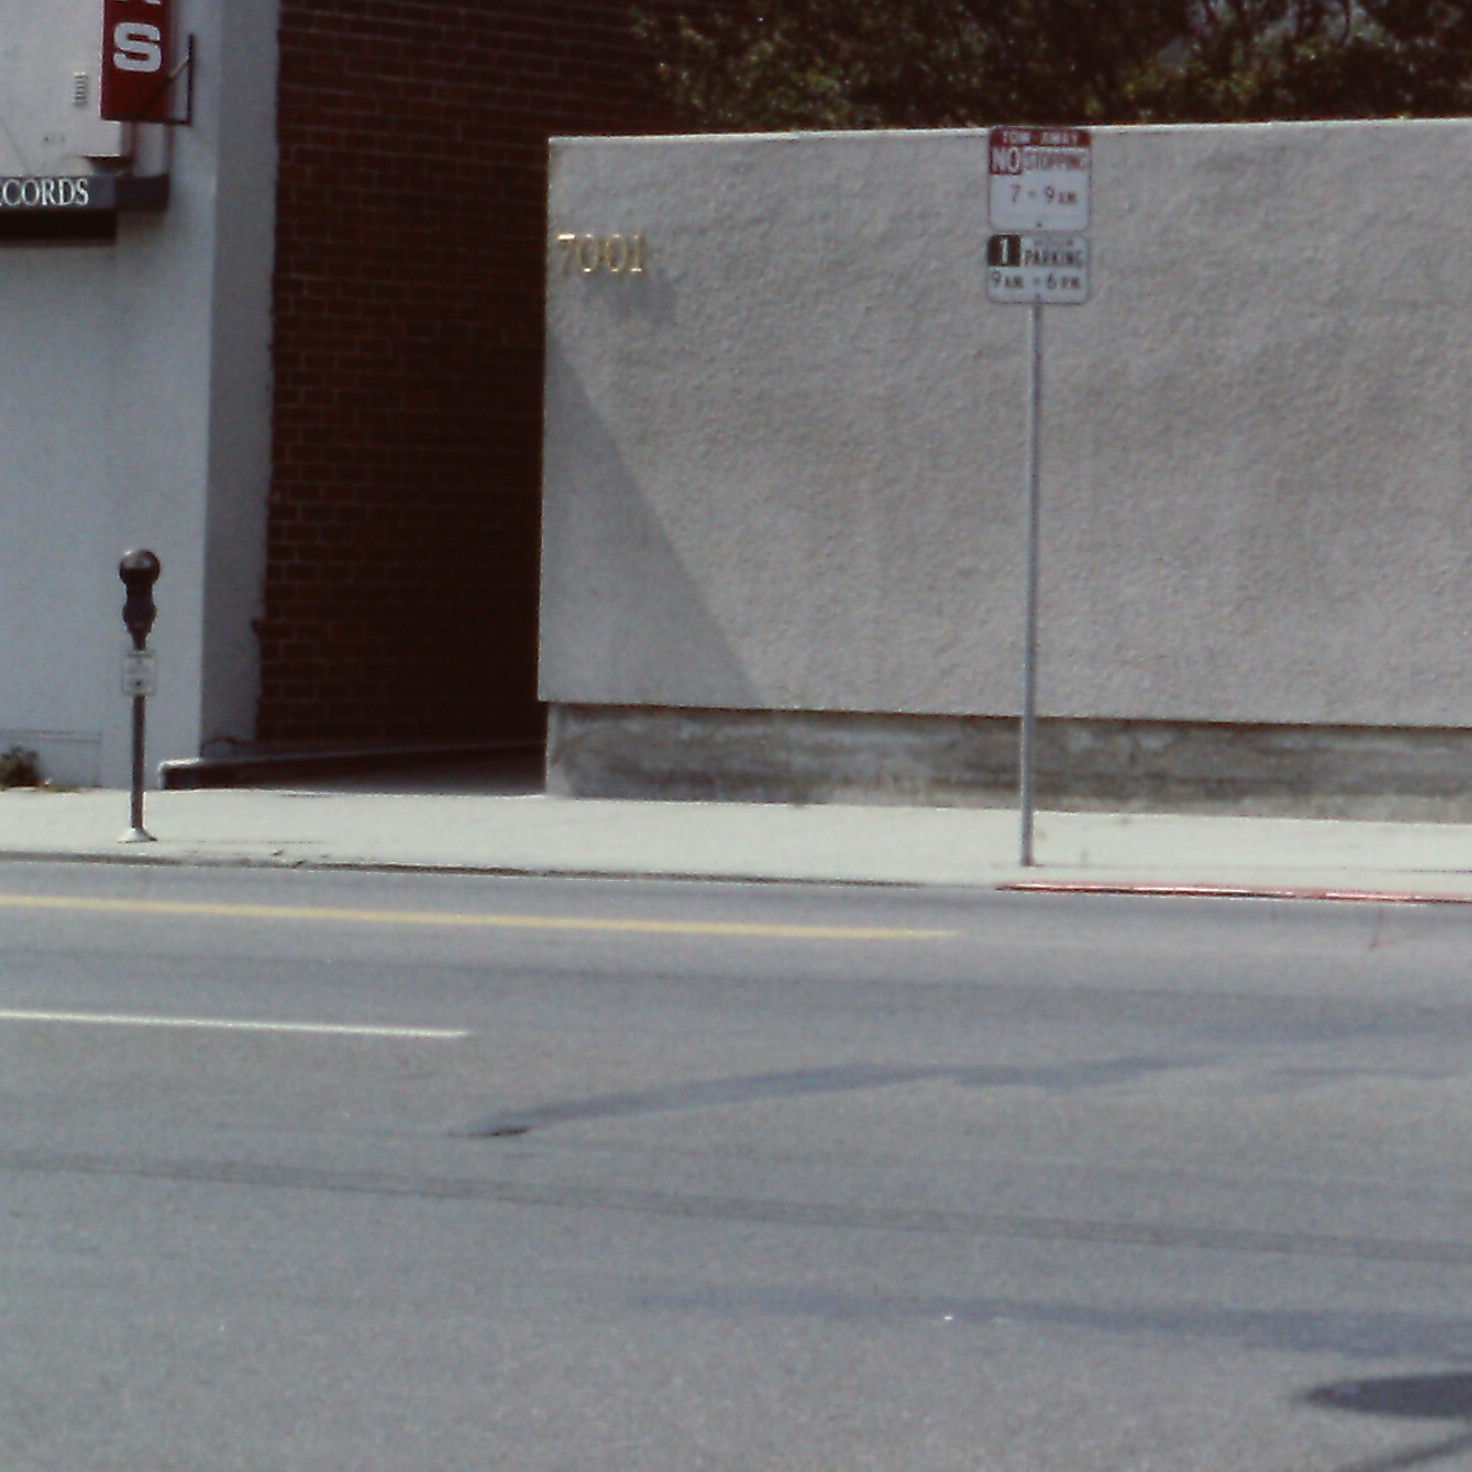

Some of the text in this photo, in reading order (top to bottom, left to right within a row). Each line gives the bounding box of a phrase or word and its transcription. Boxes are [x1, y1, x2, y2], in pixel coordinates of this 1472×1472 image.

[993, 147, 1020, 171] NO
[0, 178, 89, 206] CORDS
[558, 233, 642, 273] 7001
[1000, 237, 1009, 264] 1
